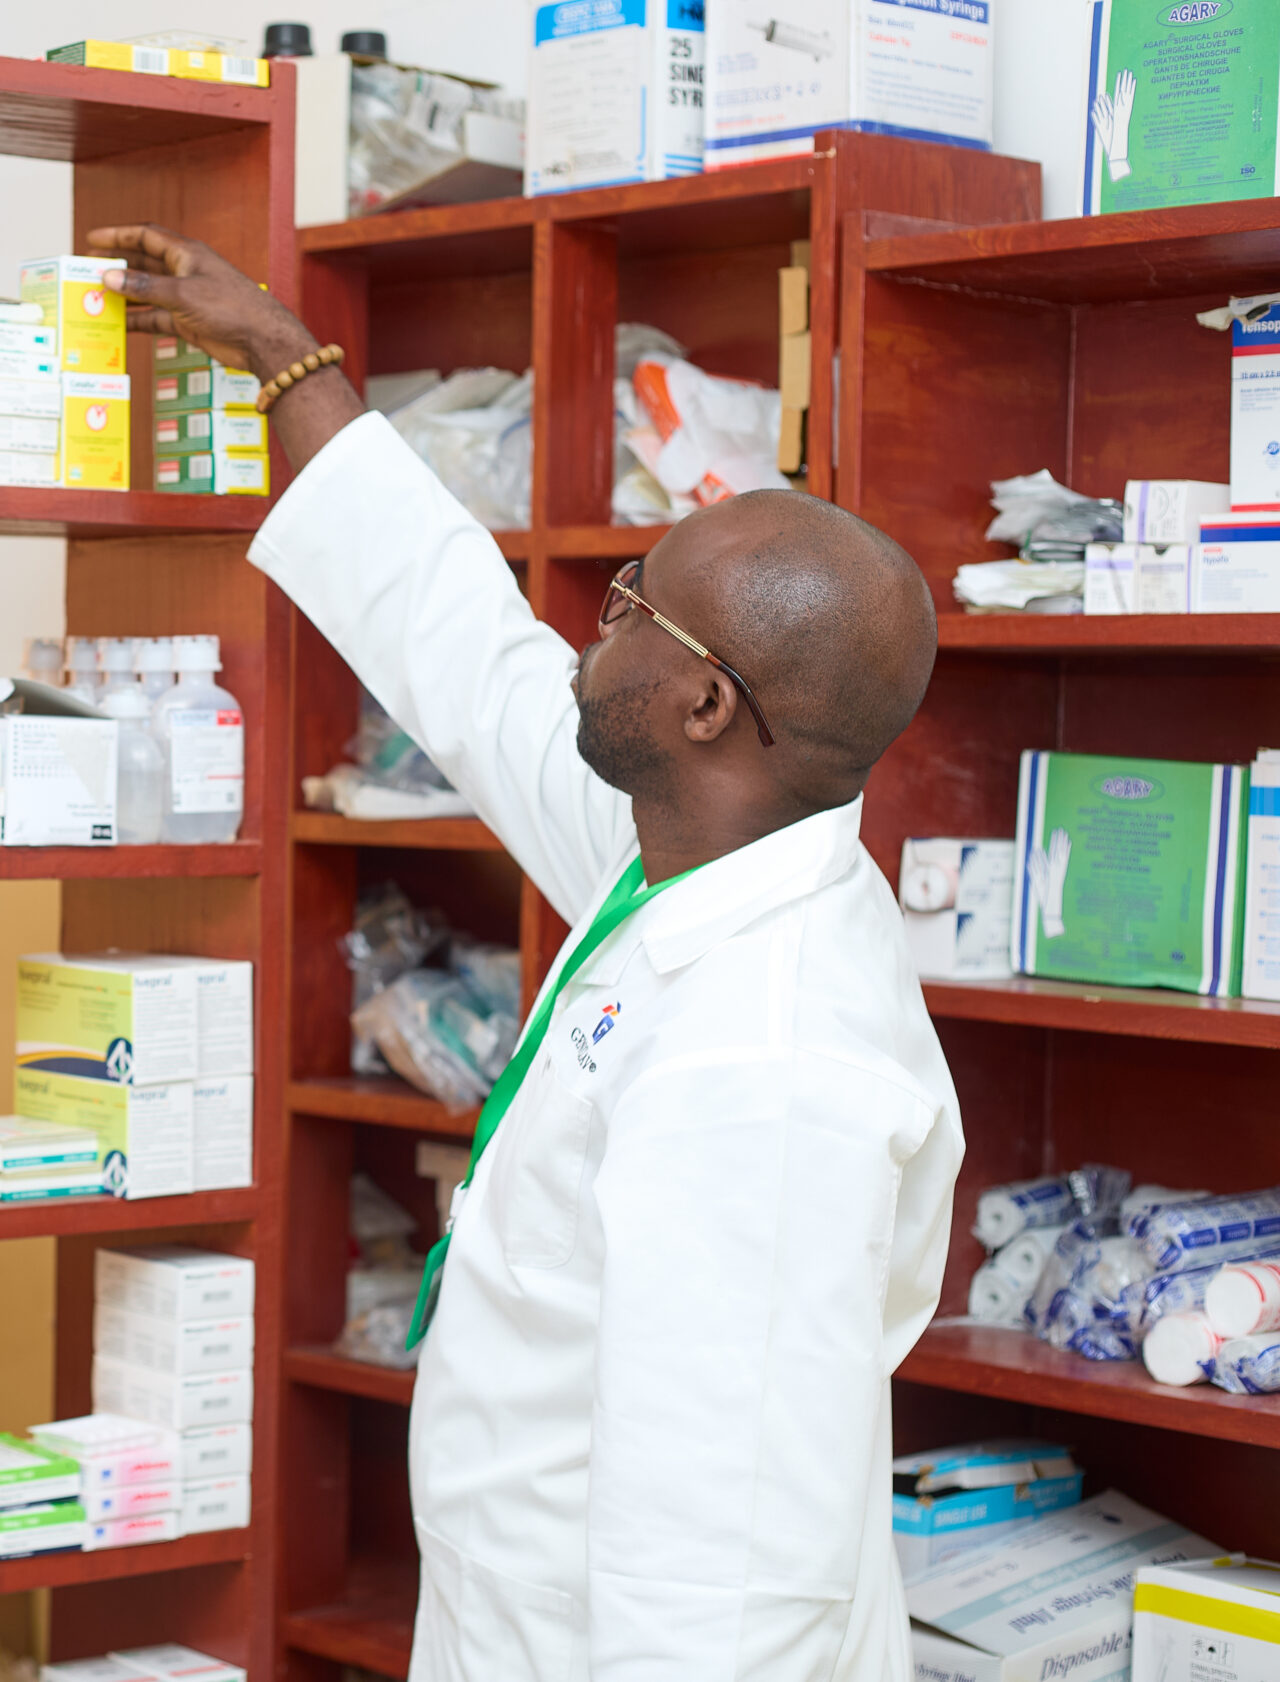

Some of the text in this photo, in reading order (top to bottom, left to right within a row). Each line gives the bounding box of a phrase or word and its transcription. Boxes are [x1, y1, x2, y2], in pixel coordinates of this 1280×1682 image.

[1168, 3, 1221, 23] AGARY
[1213, 28, 1244, 39] GLOVES
[670, 36, 693, 59] 25
[1196, 40, 1227, 51] GLOVES
[1038, 1631, 1123, 1682] Disposable
